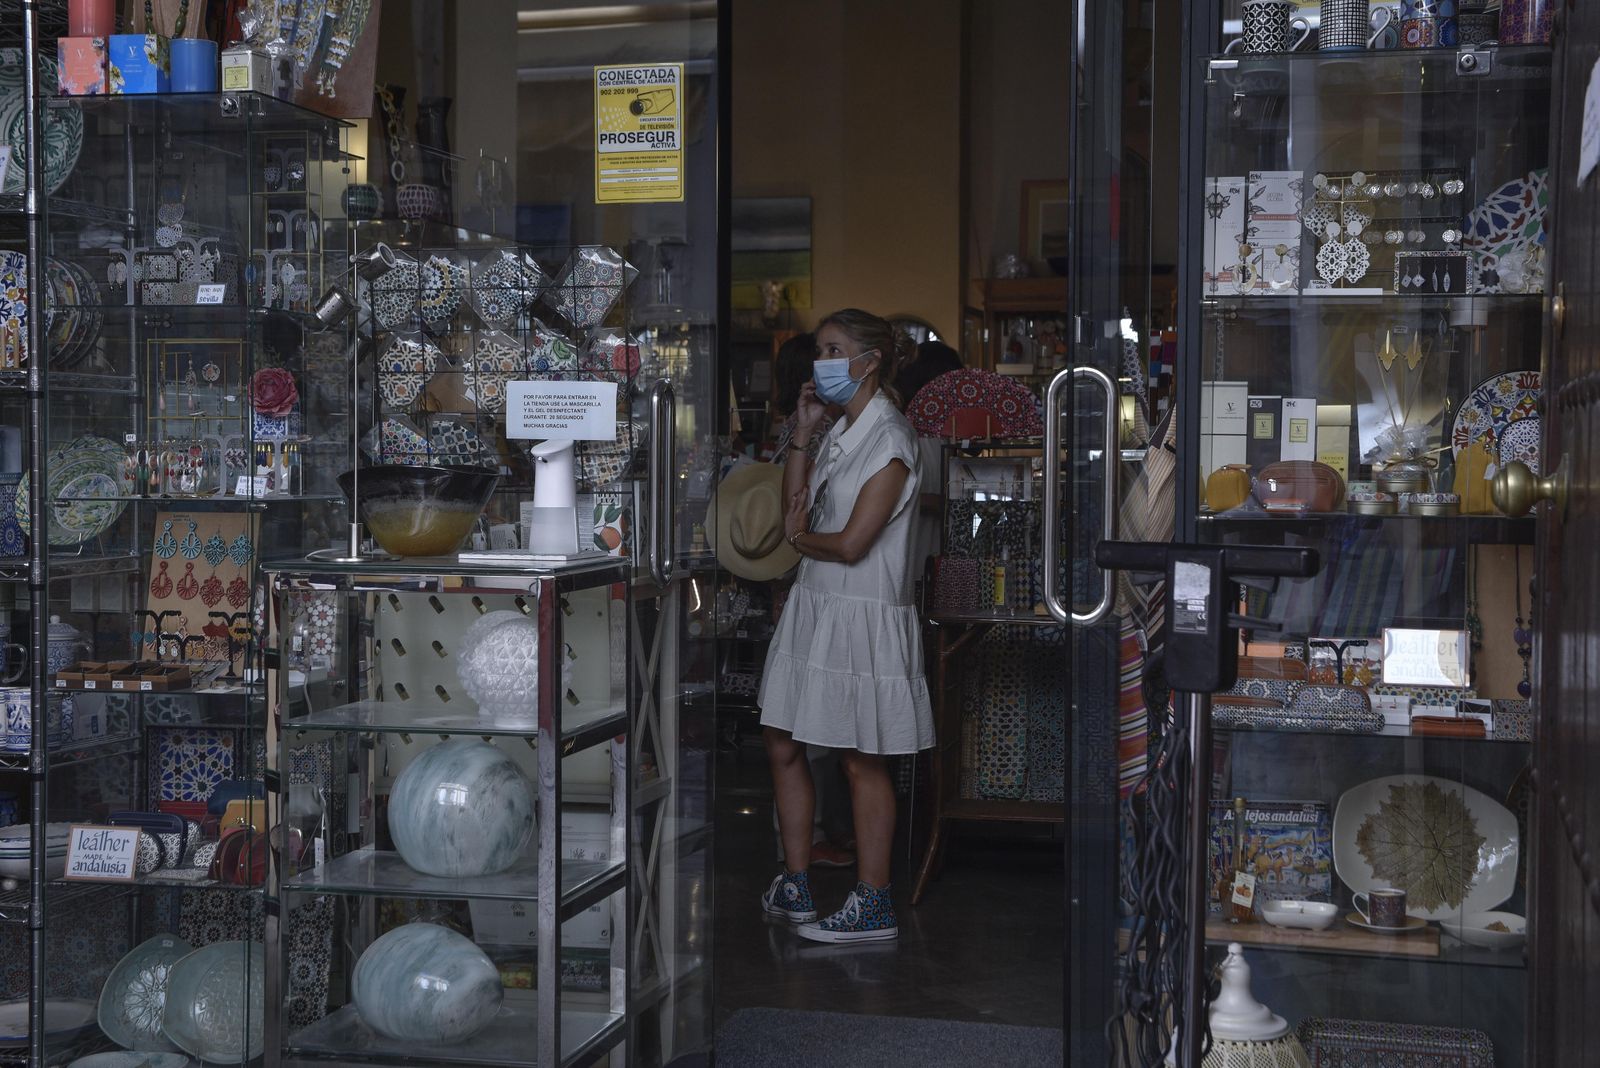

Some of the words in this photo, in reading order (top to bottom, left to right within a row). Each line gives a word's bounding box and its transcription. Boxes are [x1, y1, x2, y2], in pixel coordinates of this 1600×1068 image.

[600, 68, 676, 81] CONECTADA
[600, 131, 675, 144] PROSEGUR
[1224, 809, 1271, 823] Alejos
[78, 830, 130, 852] leather
[72, 860, 126, 873] andalusia
